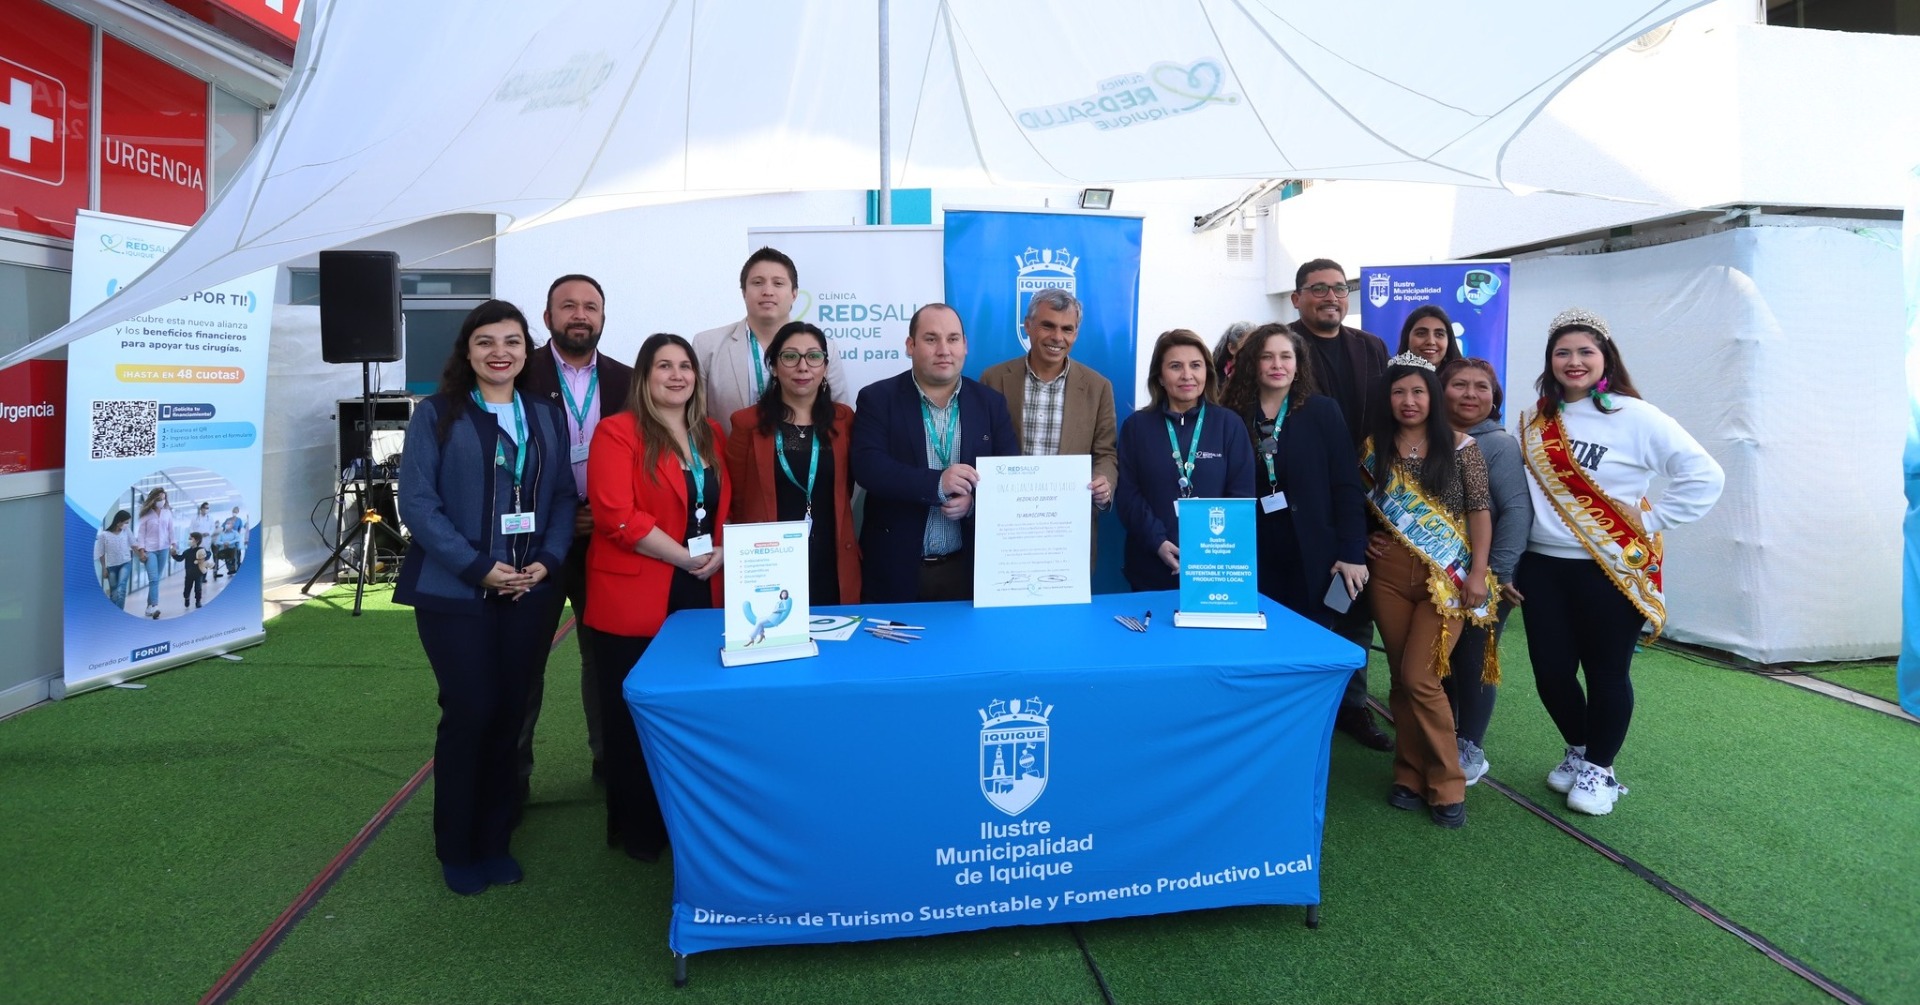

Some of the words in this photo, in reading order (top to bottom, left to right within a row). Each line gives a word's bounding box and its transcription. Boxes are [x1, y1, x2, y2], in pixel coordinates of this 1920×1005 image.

[106, 136, 203, 191] URGENCIA
[126, 241, 170, 254] REDSAL
[126, 251, 155, 259] IQUIQUE
[1020, 280, 1073, 289] IQUIQUE
[818, 291, 857, 300] CLÍNICA
[1393, 287, 1442, 296] Municipalidad
[193, 291, 226, 305] POR
[230, 294, 248, 307] TI!
[125, 316, 164, 324] escubre
[167, 317, 185, 326] esta
[188, 319, 215, 328] nueva
[217, 320, 248, 329] alianza
[115, 327, 122, 335] y
[125, 326, 140, 335] los
[143, 327, 193, 338] beneficios
[195, 331, 247, 341] financieros
[820, 327, 882, 340] QUIQUE
[121, 340, 146, 350] para
[149, 342, 183, 351] apoyar
[202, 343, 242, 353] cirugías.
[864, 349, 899, 362] para
[162, 371, 174, 379] EN
[177, 369, 193, 379] 48
[195, 369, 240, 380] cuotas!
[89, 658, 116, 671] Operado
[117, 655, 129, 666] por
[135, 645, 168, 660] FORUM
[172, 640, 190, 650] Sujeto
[984, 731, 1046, 742] IQUIQUE
[980, 819, 1051, 840] Ilustre
[936, 833, 1094, 866] Municipalidad
[955, 868, 983, 886] de
[990, 860, 1073, 885] Iquique
[693, 907, 792, 925] Dirección
[797, 911, 824, 927] de
[828, 909, 914, 927] Turismo
[919, 895, 1042, 921] Sustentable
[1047, 895, 1059, 911] y
[1064, 883, 1152, 906] Fomento
[1156, 865, 1260, 893] Productivo
[1264, 854, 1313, 877] Local
